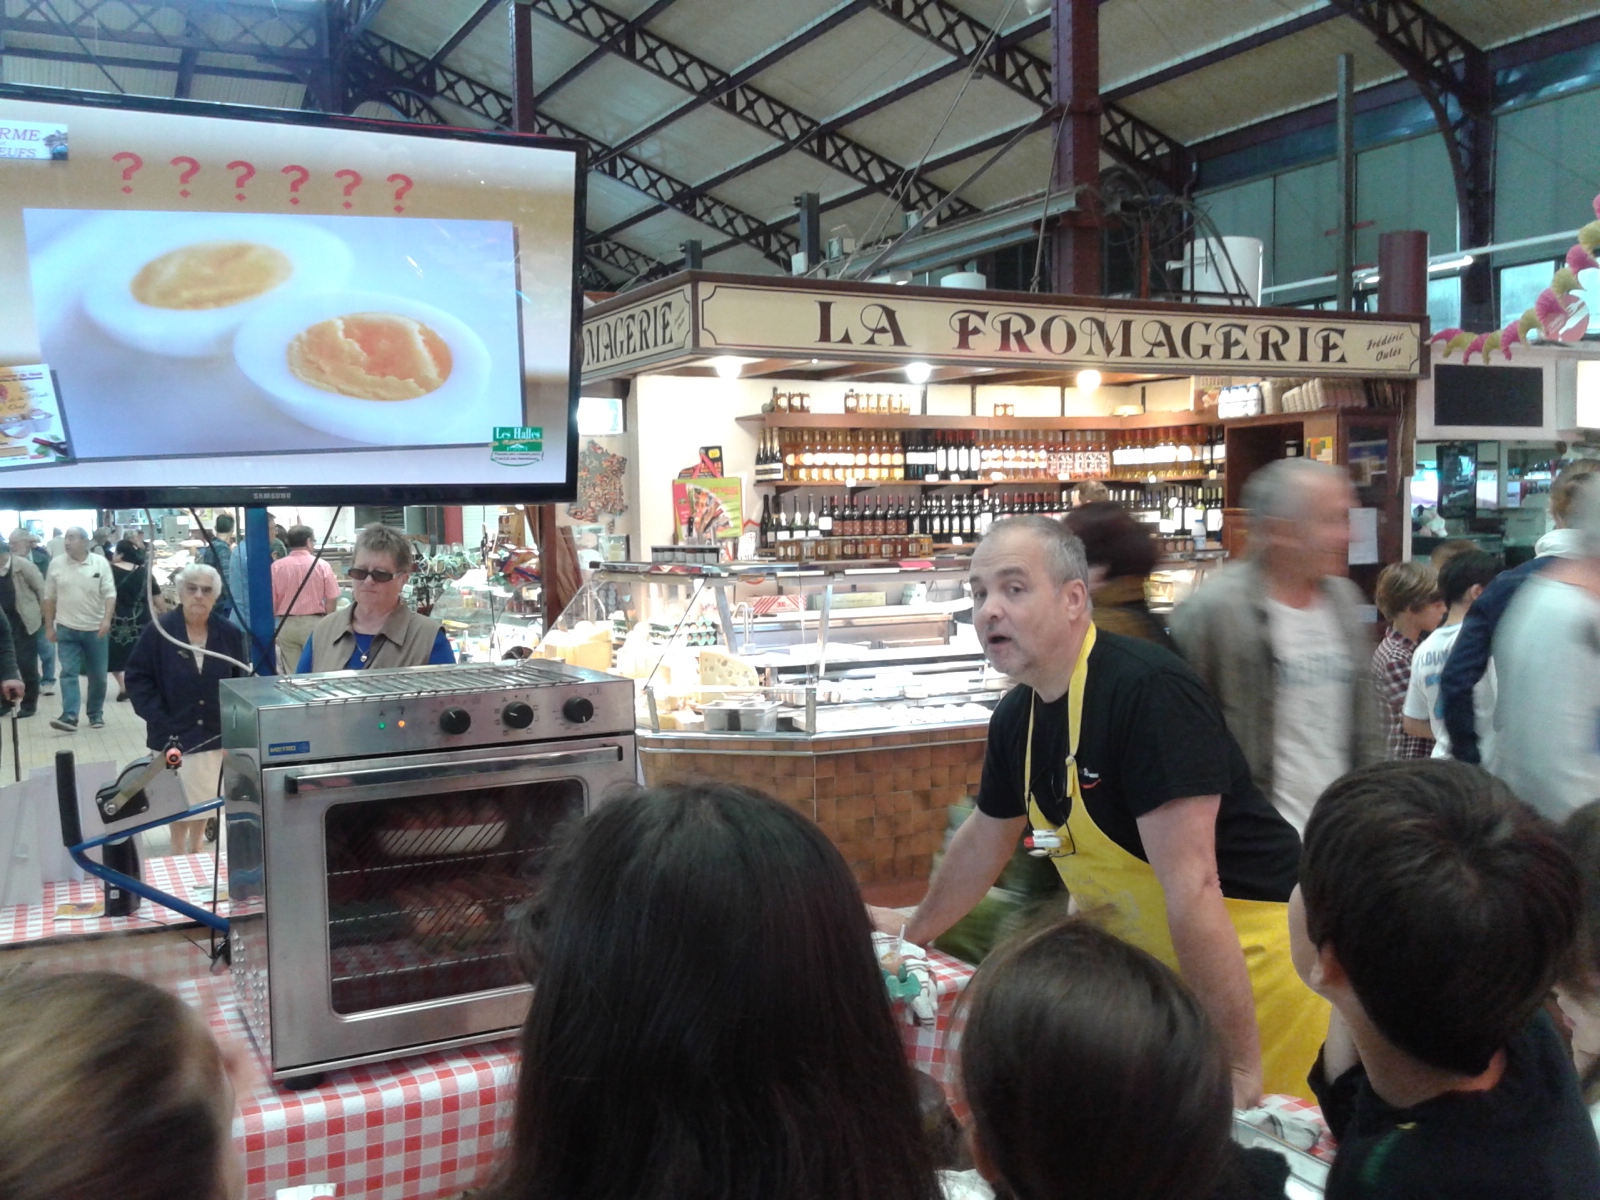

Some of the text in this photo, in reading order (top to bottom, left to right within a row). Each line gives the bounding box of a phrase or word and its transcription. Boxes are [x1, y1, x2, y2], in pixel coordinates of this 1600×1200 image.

[582, 301, 674, 367] MAGERIE
[814, 300, 1347, 363] LA FROMAGERIE
[496, 427, 541, 440] Les Halles
[253, 492, 292, 500] SAMSUNG
